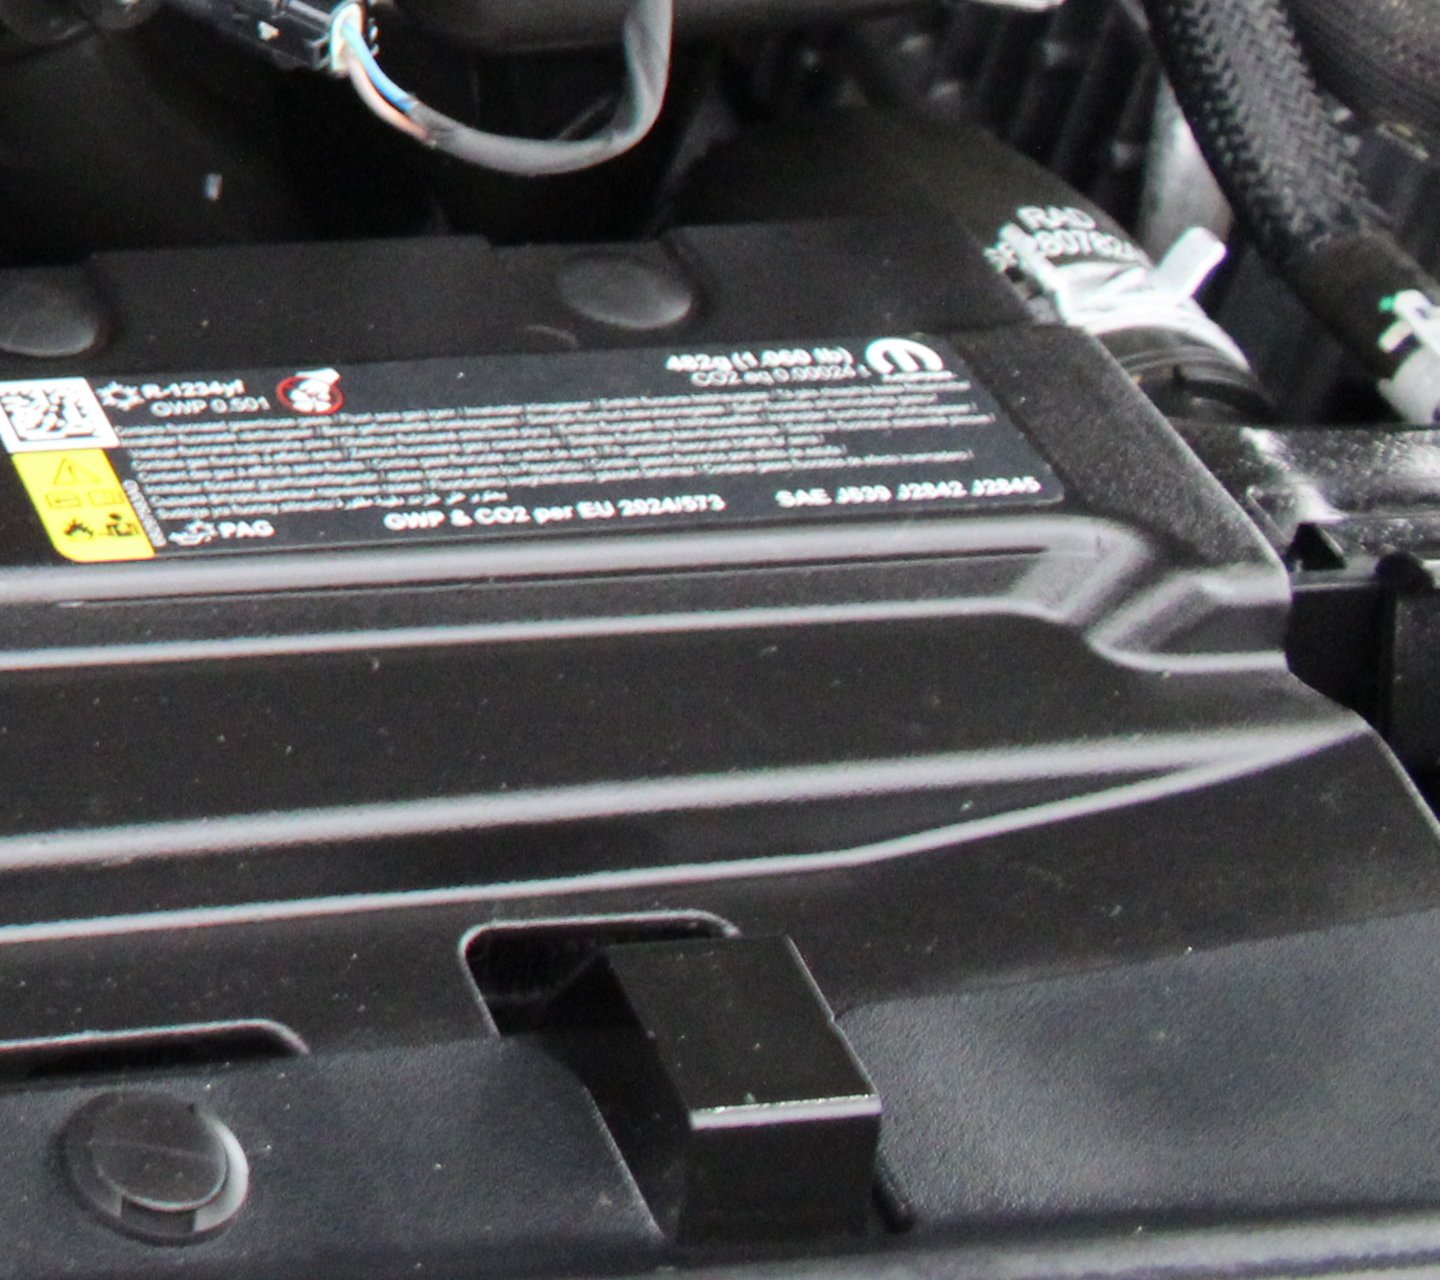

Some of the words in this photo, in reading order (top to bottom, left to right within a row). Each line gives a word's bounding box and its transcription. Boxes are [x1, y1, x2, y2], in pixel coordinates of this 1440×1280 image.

[1016, 205, 1096, 230] RAD
[141, 379, 245, 401] R-1234yf
[150, 397, 207, 417] GWP
[775, 486, 833, 508] SAE
[383, 509, 445, 530] GWP
[453, 508, 473, 527] &
[476, 503, 532, 525] CO2
[532, 503, 573, 524] per
[576, 500, 616, 519] EU
[219, 520, 275, 539] PAG
